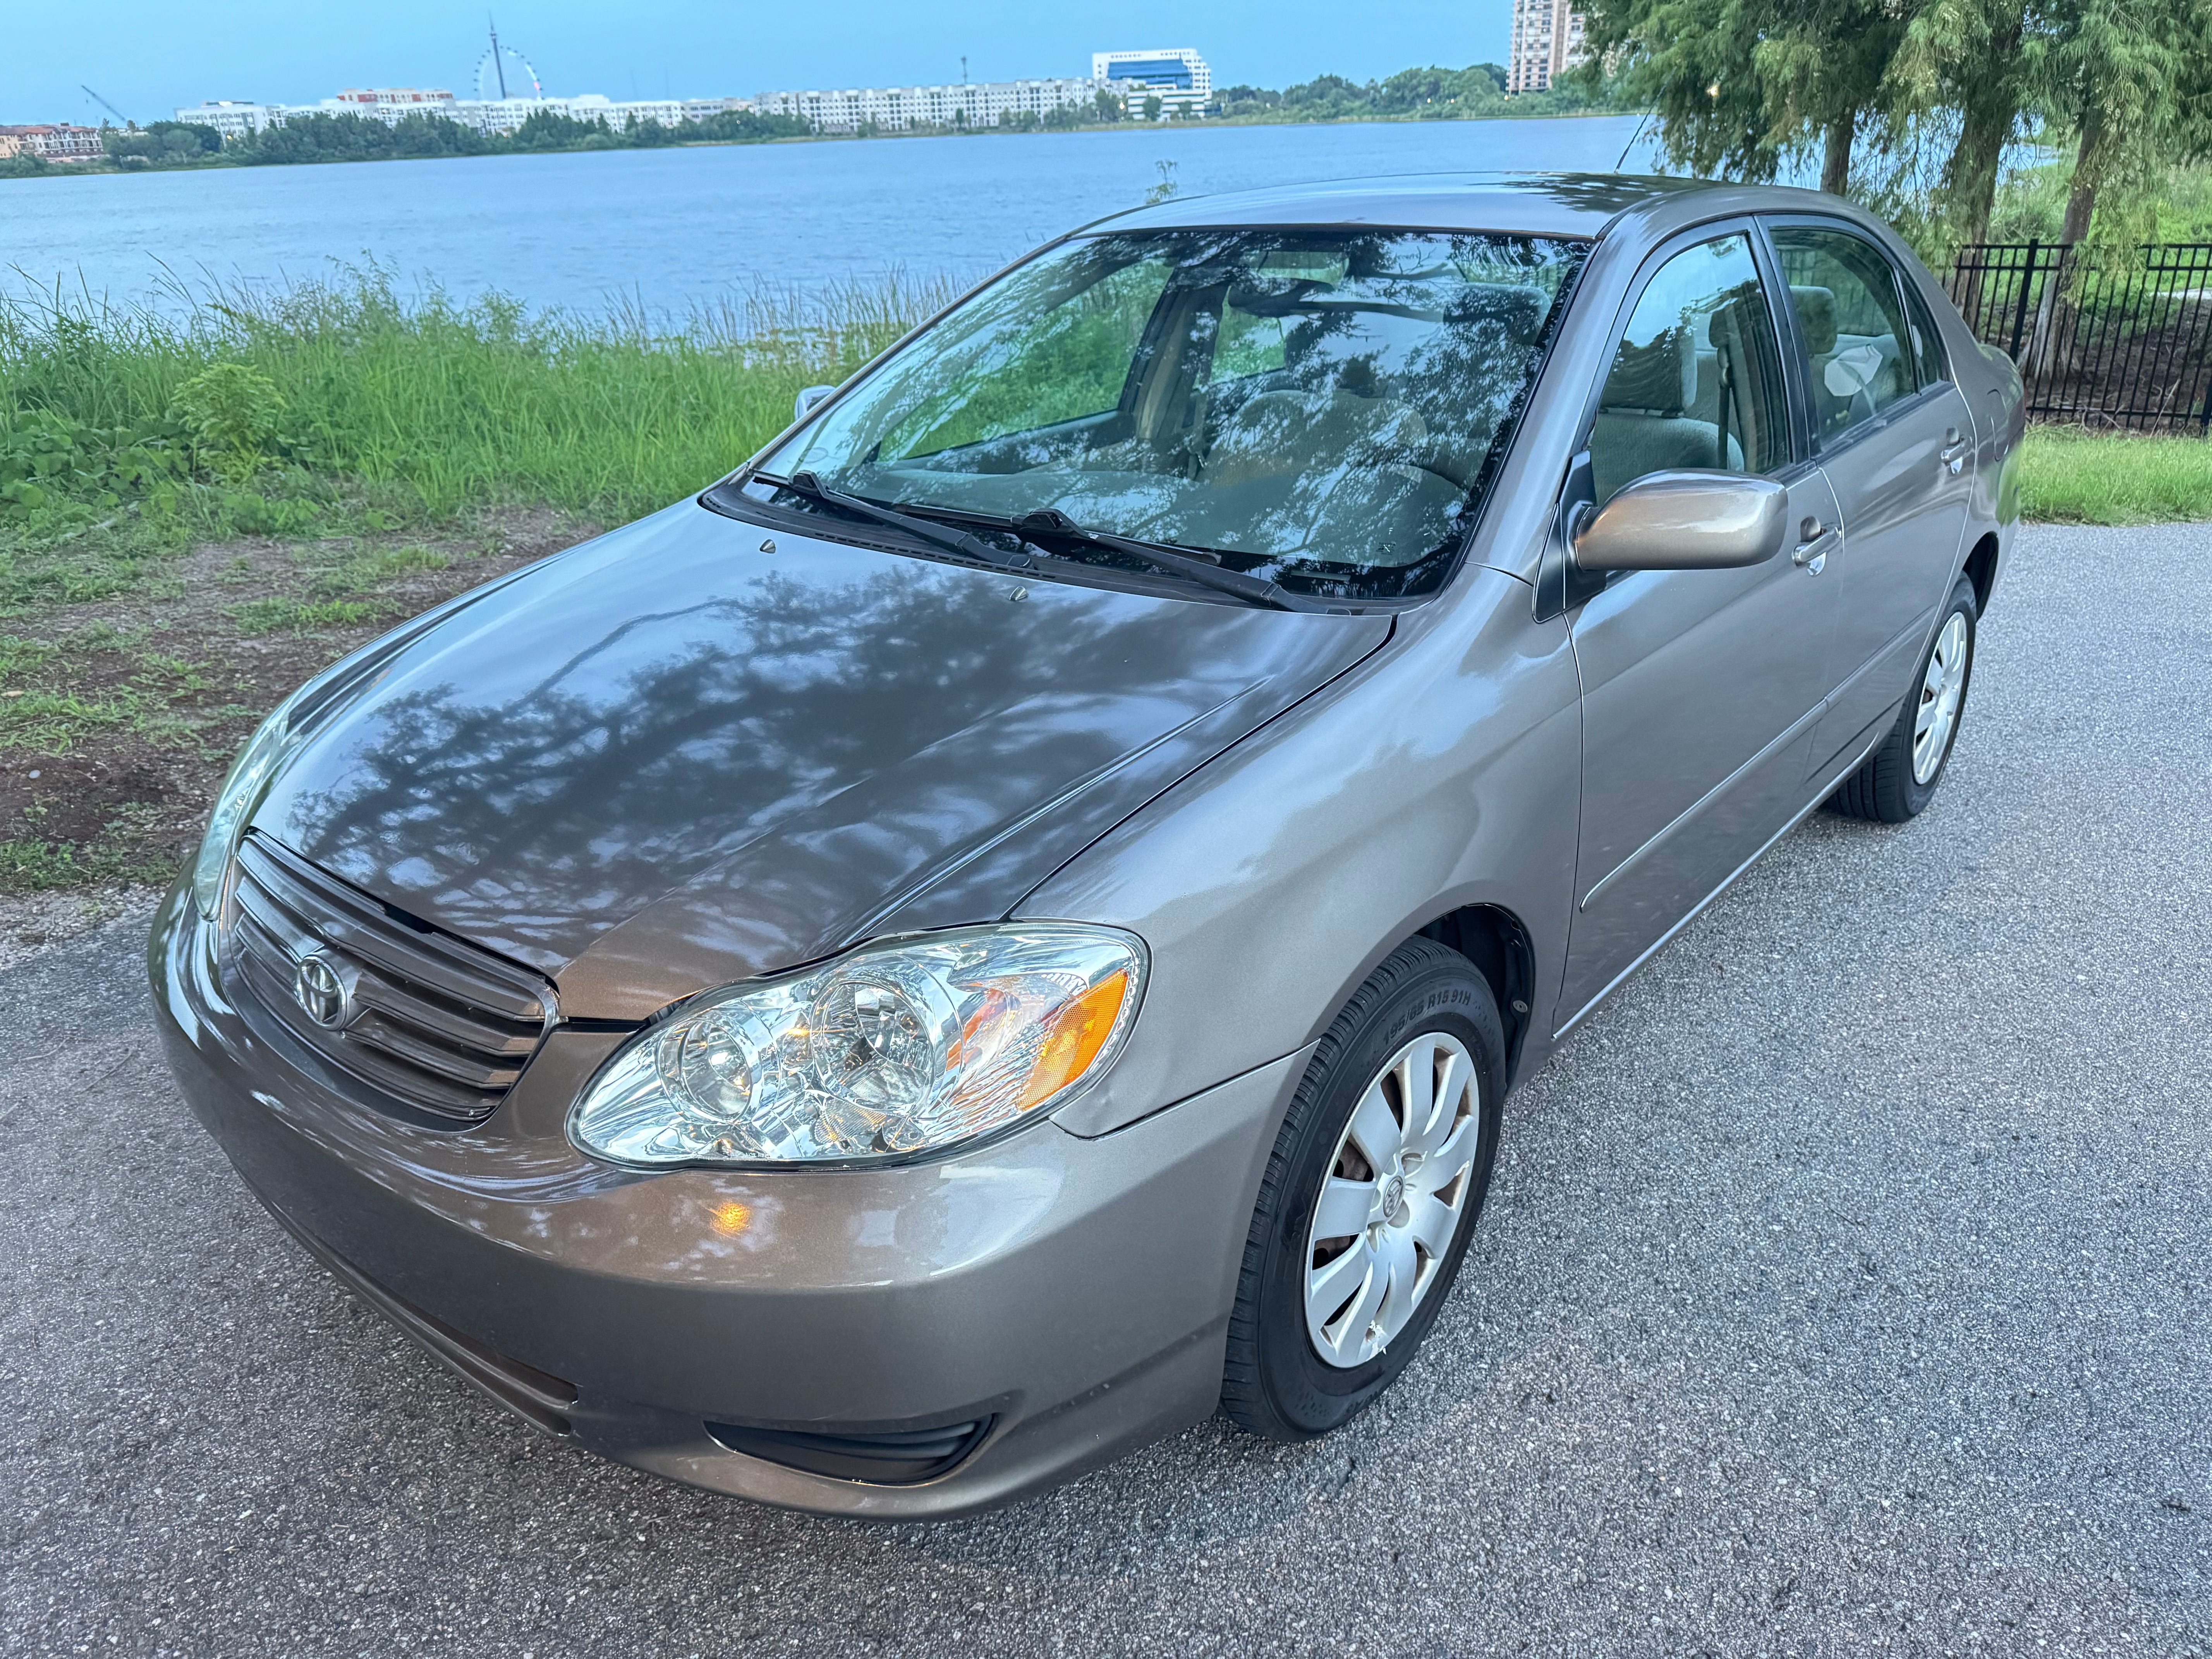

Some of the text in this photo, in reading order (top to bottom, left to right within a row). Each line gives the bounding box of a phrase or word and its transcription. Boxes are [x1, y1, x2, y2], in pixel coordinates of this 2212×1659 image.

[1383, 989, 1472, 1046] 195/65 R15 91H
